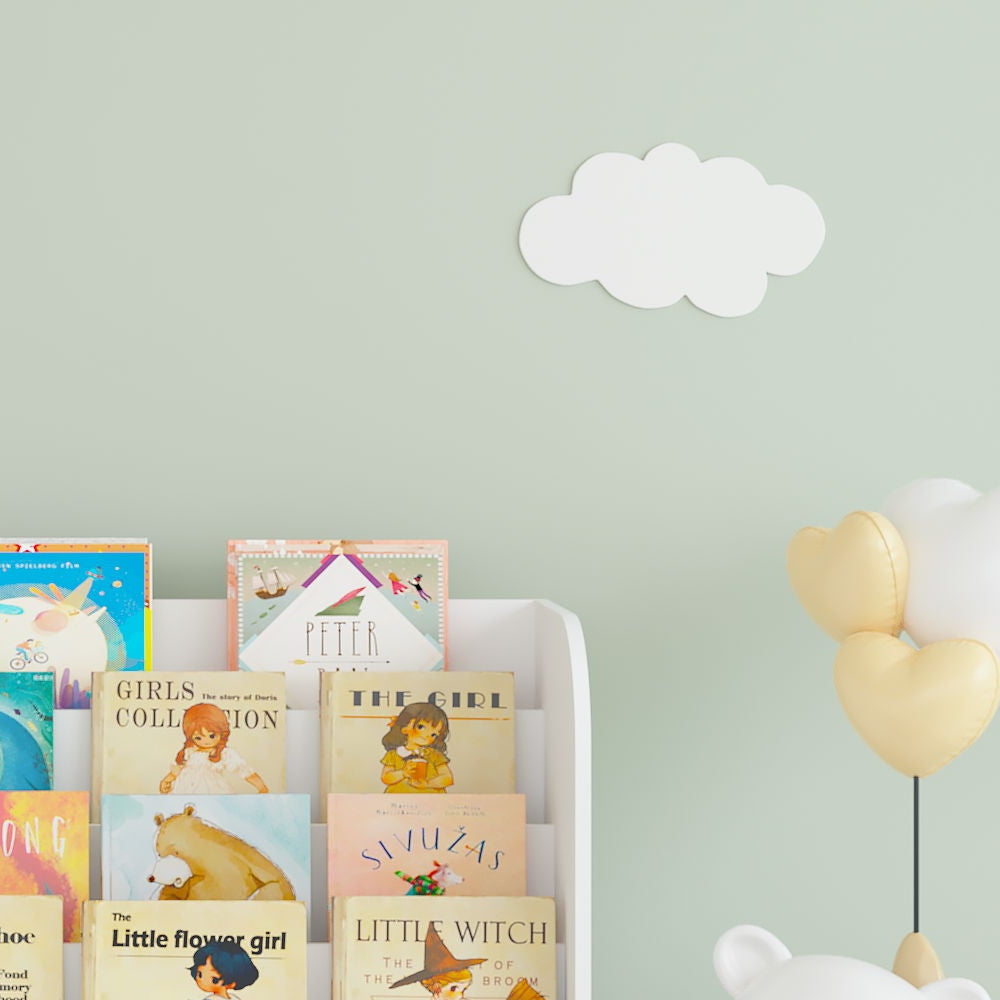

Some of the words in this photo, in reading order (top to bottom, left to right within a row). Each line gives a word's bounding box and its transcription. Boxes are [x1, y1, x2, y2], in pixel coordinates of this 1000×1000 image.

[306, 621, 379, 656] PETER
[117, 680, 195, 700] GIRLS
[348, 690, 412, 707] THE
[427, 691, 507, 709] GIRL
[116, 707, 279, 729] COLLION
[112, 912, 132, 922] The
[112, 929, 168, 948] Little
[250, 932, 287, 955] girl
[454, 920, 547, 944] WITCH
[383, 957, 413, 968] THE
[494, 960, 514, 970] OF
[364, 974, 393, 984] THE
